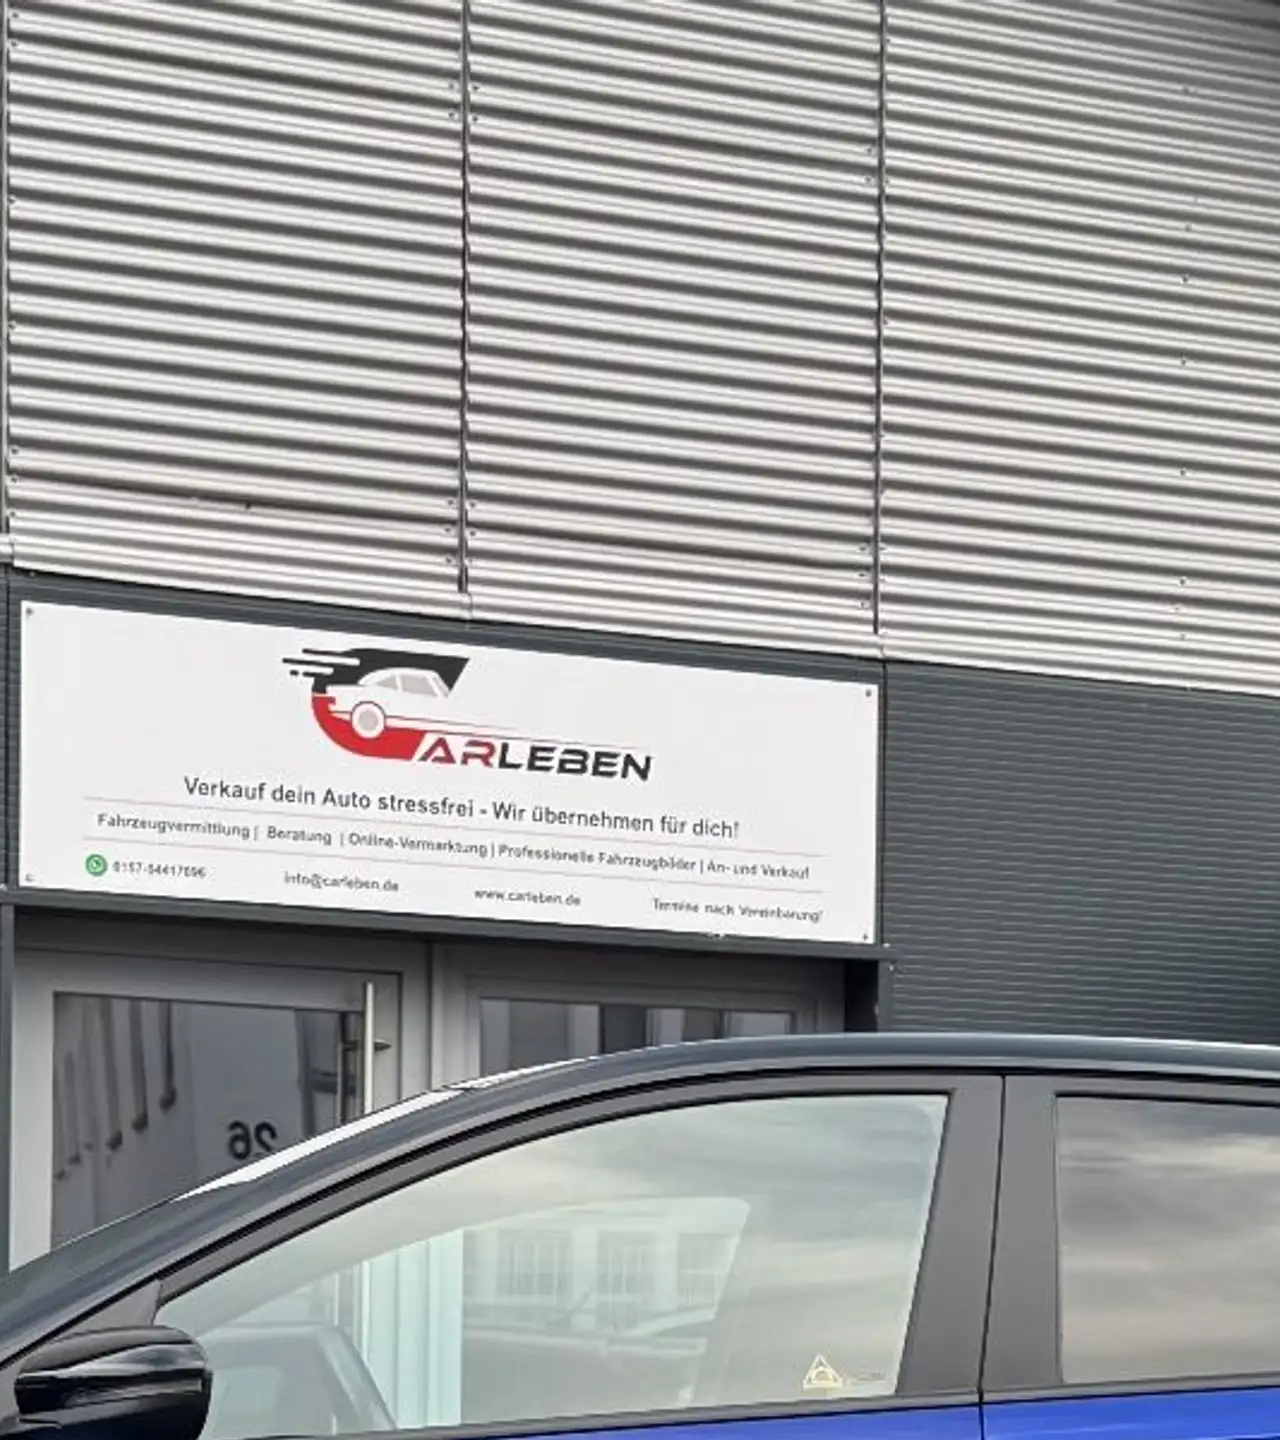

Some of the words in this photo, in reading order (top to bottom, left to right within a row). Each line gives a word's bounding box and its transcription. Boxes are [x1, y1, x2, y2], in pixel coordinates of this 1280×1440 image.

[183, 776, 267, 800] Verkauf
[271, 785, 316, 805] dein
[322, 788, 370, 810] Auto
[378, 794, 474, 817] stressfrei
[492, 801, 526, 821] Wir
[532, 805, 654, 832] übernehmen
[661, 815, 687, 834] für
[693, 818, 739, 839] dich!
[97, 813, 251, 841] Fahrzeugvermittlung
[267, 826, 332, 846] Beratung
[349, 832, 488, 858] Online-Vermarktung
[498, 843, 595, 864] Professionelle
[598, 852, 697, 872] Fahrzeugbilder
[733, 863, 757, 876] und
[762, 863, 810, 879] Verkauf
[284, 871, 399, 892] info@carleben.de
[474, 889, 582, 907] www.carleben.de
[704, 904, 735, 916] nach
